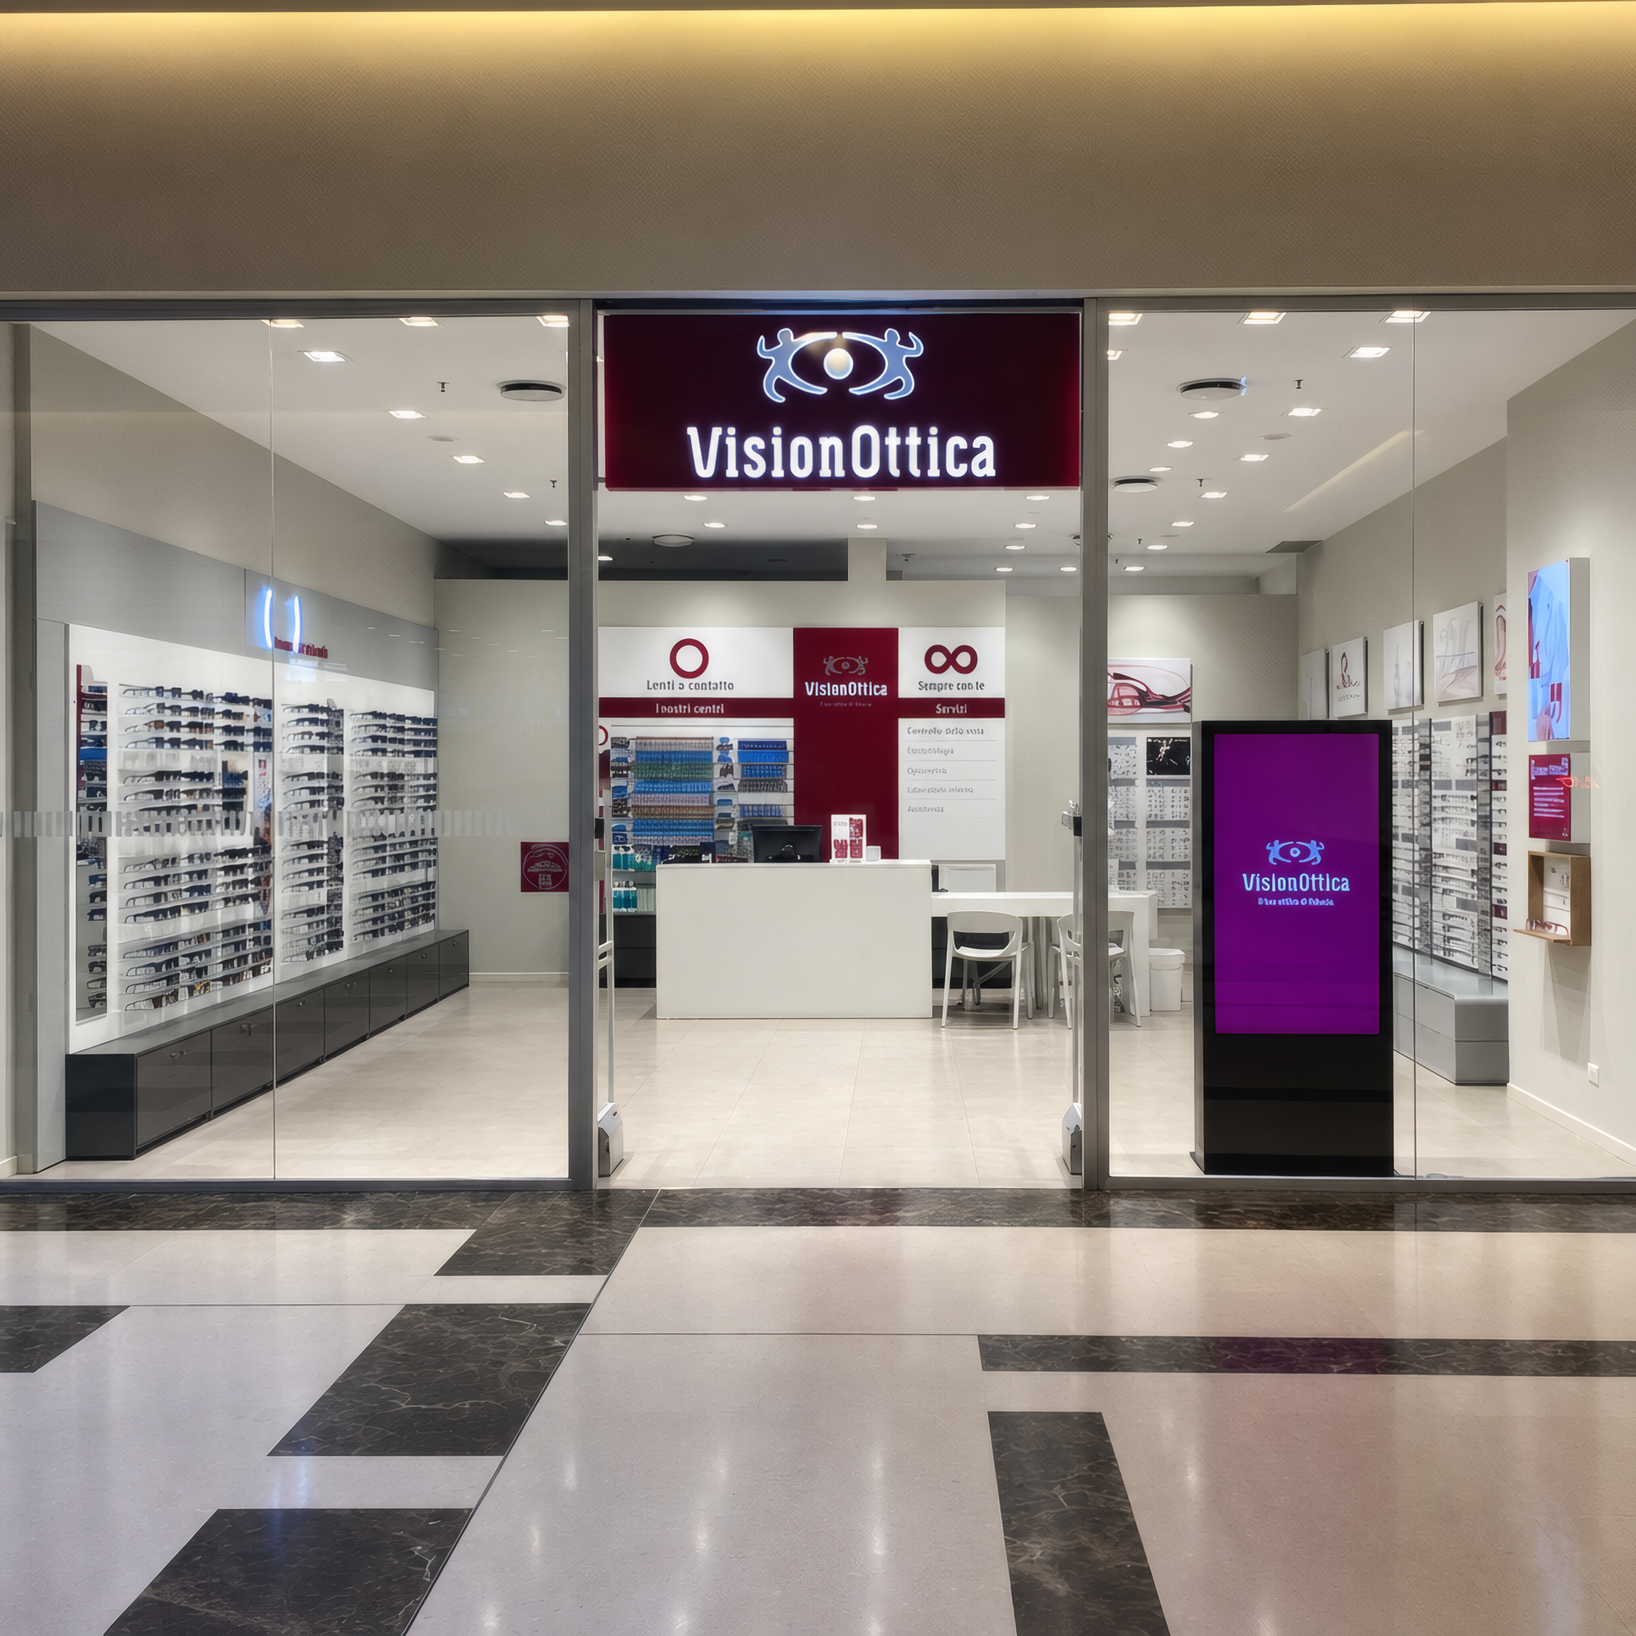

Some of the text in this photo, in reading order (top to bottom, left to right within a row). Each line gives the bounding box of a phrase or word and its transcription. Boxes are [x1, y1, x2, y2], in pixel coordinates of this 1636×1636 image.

[686, 424, 996, 479] VisionOttica
[804, 681, 888, 696] VisionOttica
[1242, 873, 1351, 892] VisionOttica
